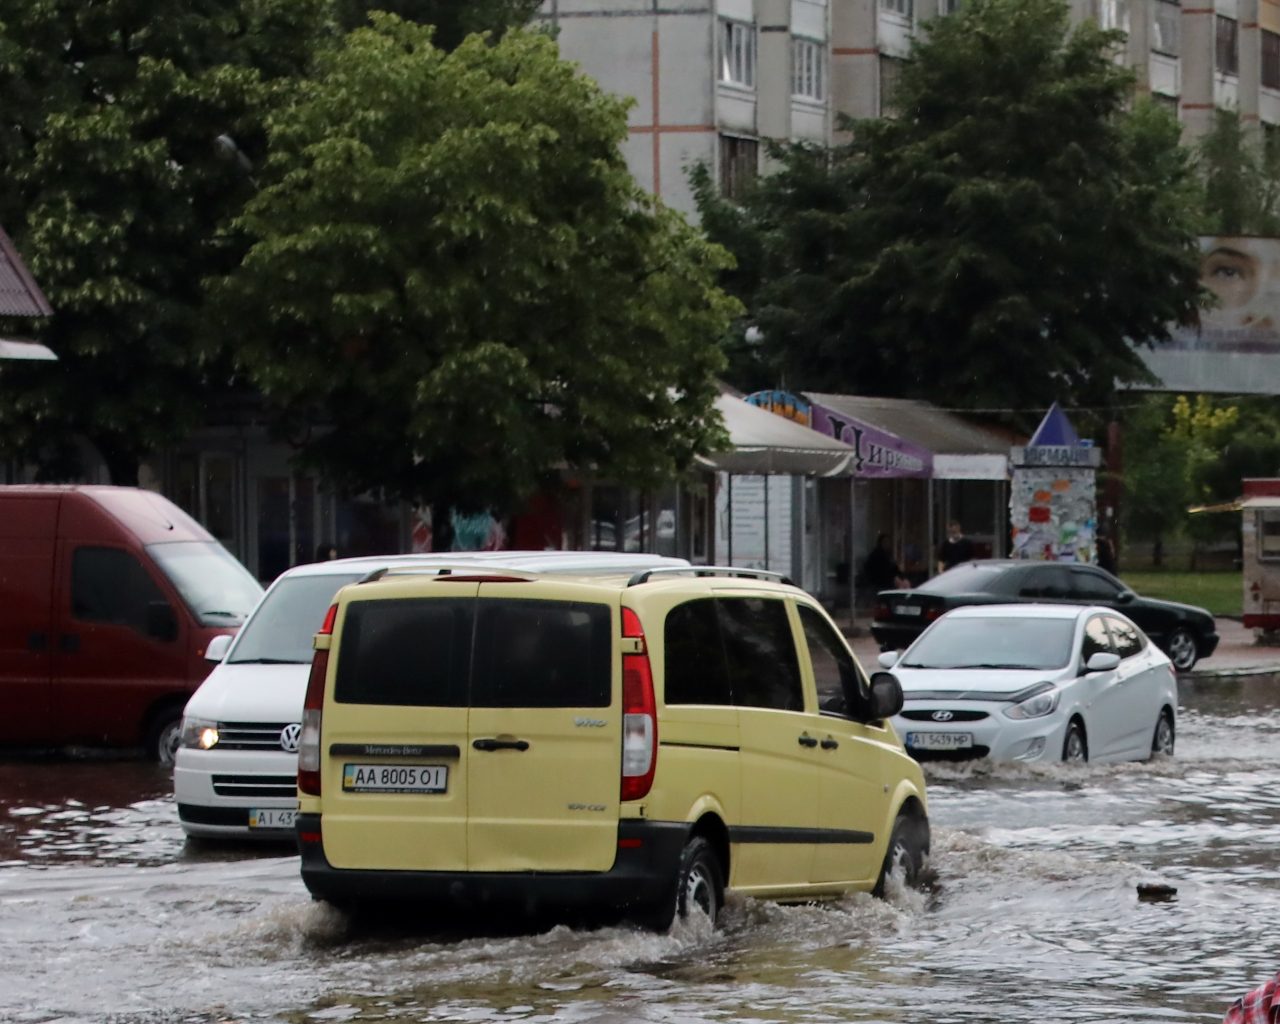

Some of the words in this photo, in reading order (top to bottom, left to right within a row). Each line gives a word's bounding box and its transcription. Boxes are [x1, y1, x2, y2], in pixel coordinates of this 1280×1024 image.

[364, 745, 423, 756] Mercedes-Benz
[355, 768, 377, 785] AA
[381, 768, 416, 786] 8005
[258, 811, 273, 825] AI
